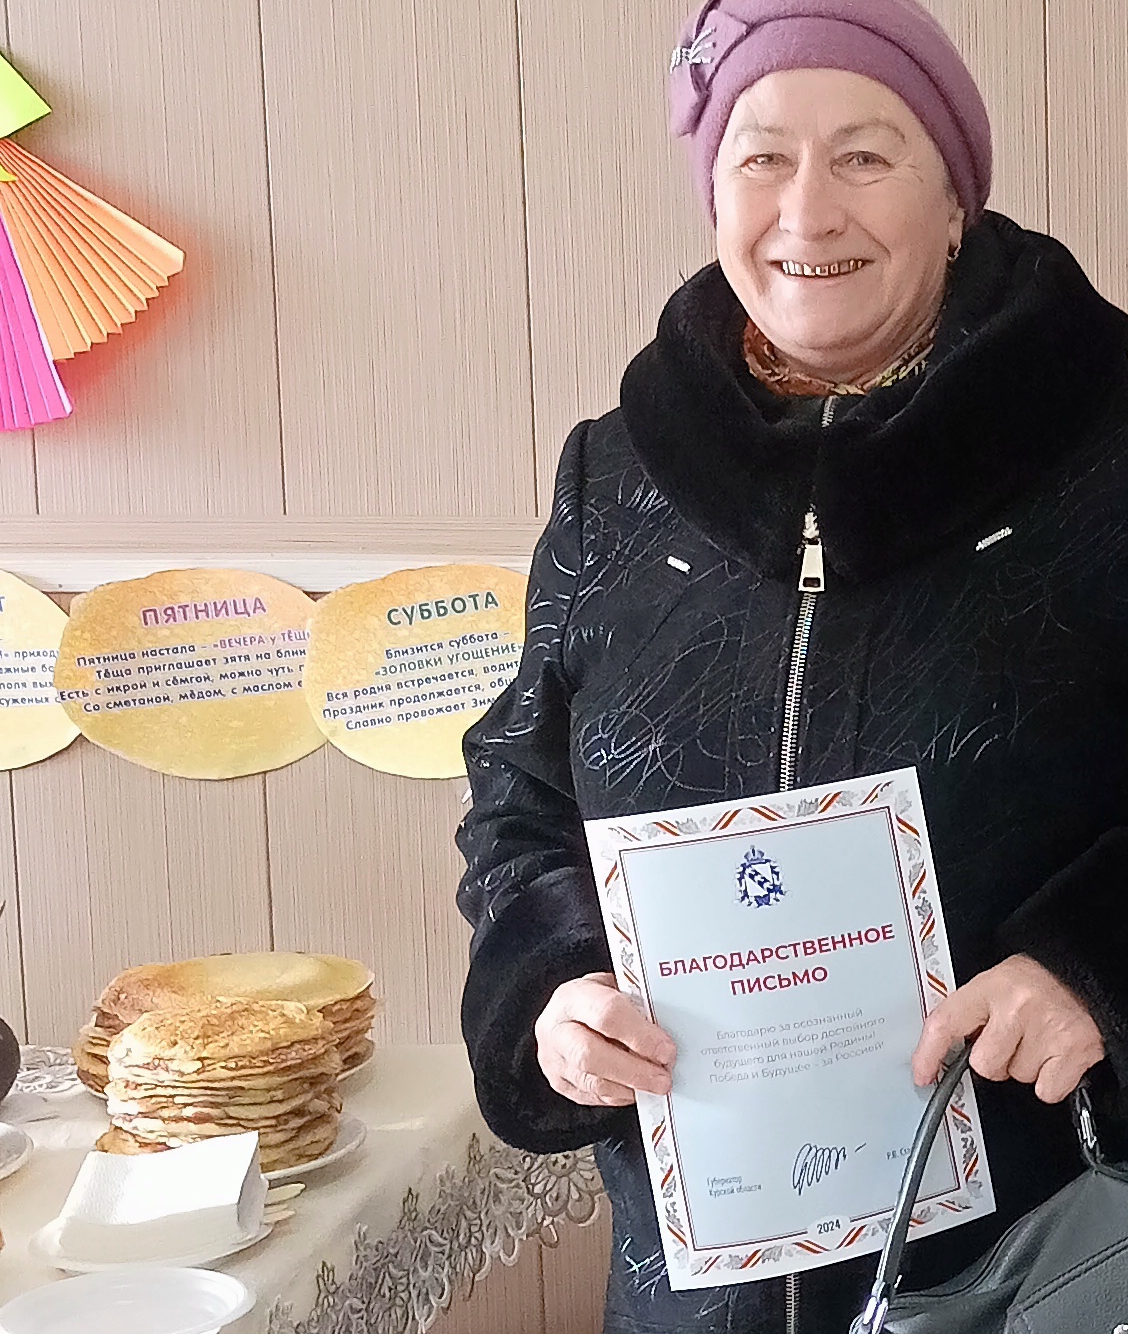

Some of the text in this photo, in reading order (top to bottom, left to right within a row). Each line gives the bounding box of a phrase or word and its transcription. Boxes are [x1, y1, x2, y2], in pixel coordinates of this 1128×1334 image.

[142, 597, 267, 626] ПЯТНИЦА
[387, 591, 499, 626] СУББОТА
[77, 651, 137, 668] Пятница
[141, 643, 196, 659] настала
[281, 630, 310, 643] ТЁЩ
[385, 641, 444, 661] Близится
[448, 630, 499, 651] суббота
[96, 667, 132, 681] Тёща
[137, 656, 217, 677] приглашает
[255, 650, 271, 662] на
[276, 646, 307, 660] блин
[59, 688, 90, 702] Есть
[106, 678, 147, 695] икрой
[219, 667, 262, 683] можно
[267, 664, 294, 680] чуть
[84, 701, 101, 714] Со
[242, 679, 293, 695] маслом
[326, 689, 348, 703] Вся
[353, 683, 392, 700] родня
[322, 700, 385, 720] Праздник
[346, 714, 392, 731] Славно
[397, 701, 466, 724] провожает
[659, 923, 896, 977] БЛАГОДАРСТВЕННОЕ
[730, 966, 829, 996] ПИСЬМО
[716, 1025, 776, 1041] Благодарю
[767, 1052, 787, 1065] для
[817, 1218, 841, 1235] 2024
